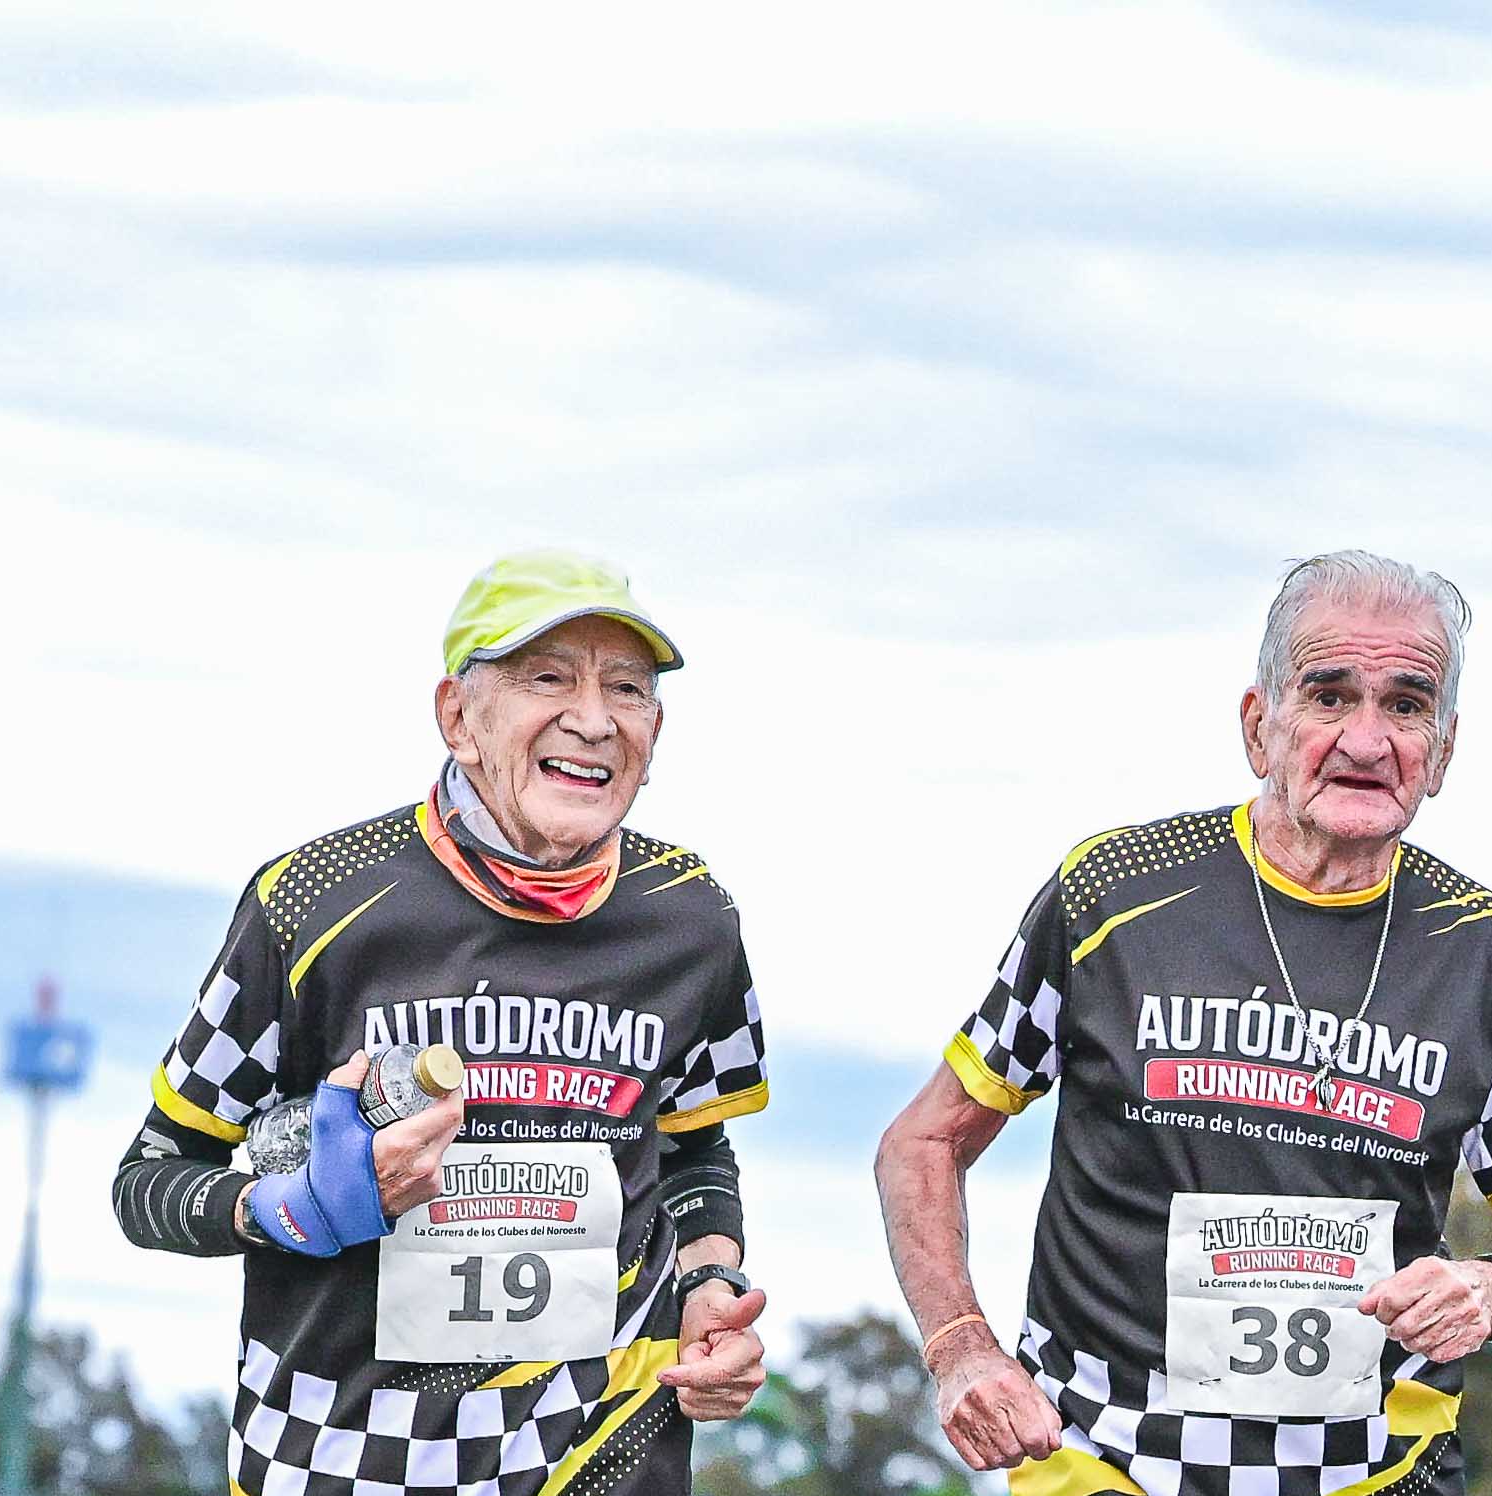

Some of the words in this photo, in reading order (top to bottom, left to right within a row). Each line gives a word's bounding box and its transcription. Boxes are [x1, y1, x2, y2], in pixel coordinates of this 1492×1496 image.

[364, 979, 665, 1071] AUTÓDROMO
[1135, 985, 1449, 1097] AUTÓDROMO
[463, 1067, 537, 1100] NING
[546, 1068, 617, 1110] RACE
[1175, 1064, 1308, 1107] RUNNING
[457, 1126, 466, 1137] e
[471, 1118, 496, 1137] los
[501, 1119, 557, 1138] Clubes
[560, 1119, 587, 1138] del
[1124, 1102, 1139, 1121] La
[1141, 1105, 1205, 1129] Carrera
[1209, 1113, 1232, 1134] de
[1236, 1116, 1262, 1138] los
[1265, 1123, 1327, 1149] Clubes
[1330, 1133, 1360, 1154] del
[441, 1154, 588, 1198] UTÓDROMO
[445, 1198, 517, 1221] RUNNING
[520, 1198, 561, 1219] RACE
[414, 1226, 426, 1237] La
[428, 1227, 464, 1237] Carrera
[466, 1226, 480, 1236] de
[481, 1226, 496, 1236] los
[497, 1226, 528, 1236] Clubes
[530, 1226, 545, 1235] del
[547, 1226, 587, 1235] Noroeste
[1202, 1208, 1368, 1255] AUTÓDROMO
[1228, 1251, 1298, 1272] RUNNING
[1303, 1251, 1340, 1274] RACE
[448, 1252, 551, 1323] 19
[1199, 1278, 1210, 1288] La
[1211, 1278, 1247, 1289] Carrera
[1249, 1278, 1262, 1289] de
[1264, 1279, 1278, 1289] los
[1279, 1279, 1311, 1290] Clubes
[1312, 1279, 1327, 1290] del
[1328, 1280, 1364, 1292] Noroeste
[1229, 1306, 1332, 1377] 38
